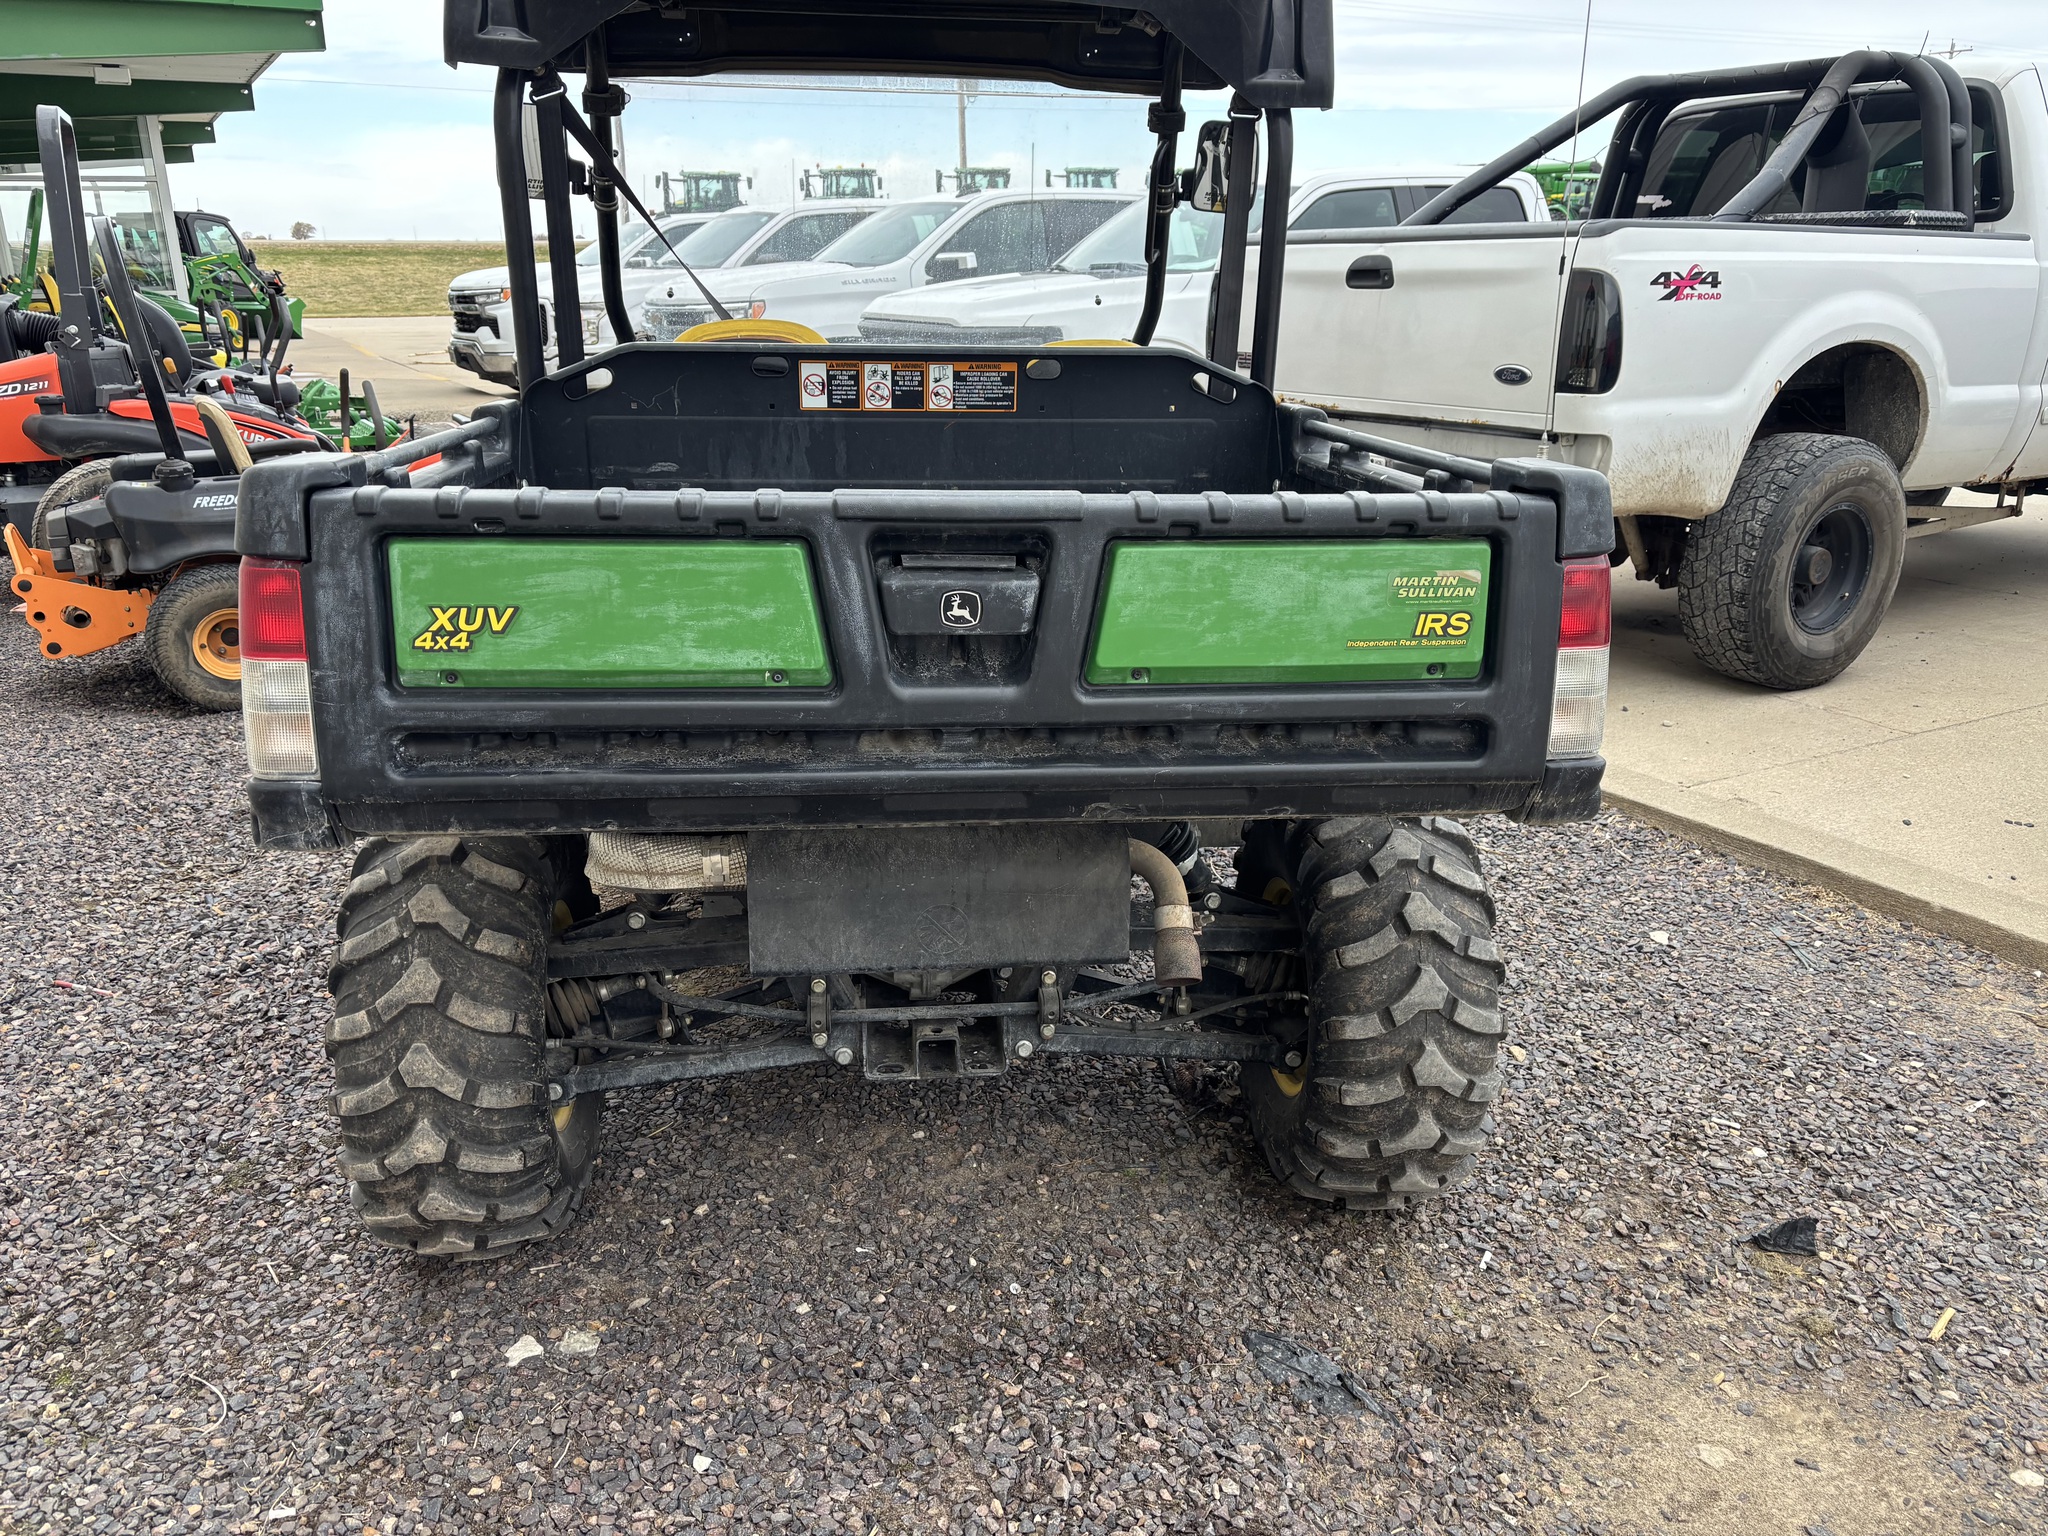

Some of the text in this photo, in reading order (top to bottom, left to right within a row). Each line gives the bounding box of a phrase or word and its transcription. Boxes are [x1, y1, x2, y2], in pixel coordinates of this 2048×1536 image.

[1680, 292, 1722, 301] OFF-ROAD
[1502, 369, 1521, 380] Ford
[24, 381, 49, 391] 1211
[1393, 576, 1459, 587] MARTIN
[1397, 587, 1477, 598] SULLIVAN
[427, 606, 516, 632] XUV
[1414, 612, 1471, 636] IRS
[414, 632, 470, 650] 4x4
[1347, 639, 1398, 647] Independent
[1421, 638, 1467, 647] Suspension
